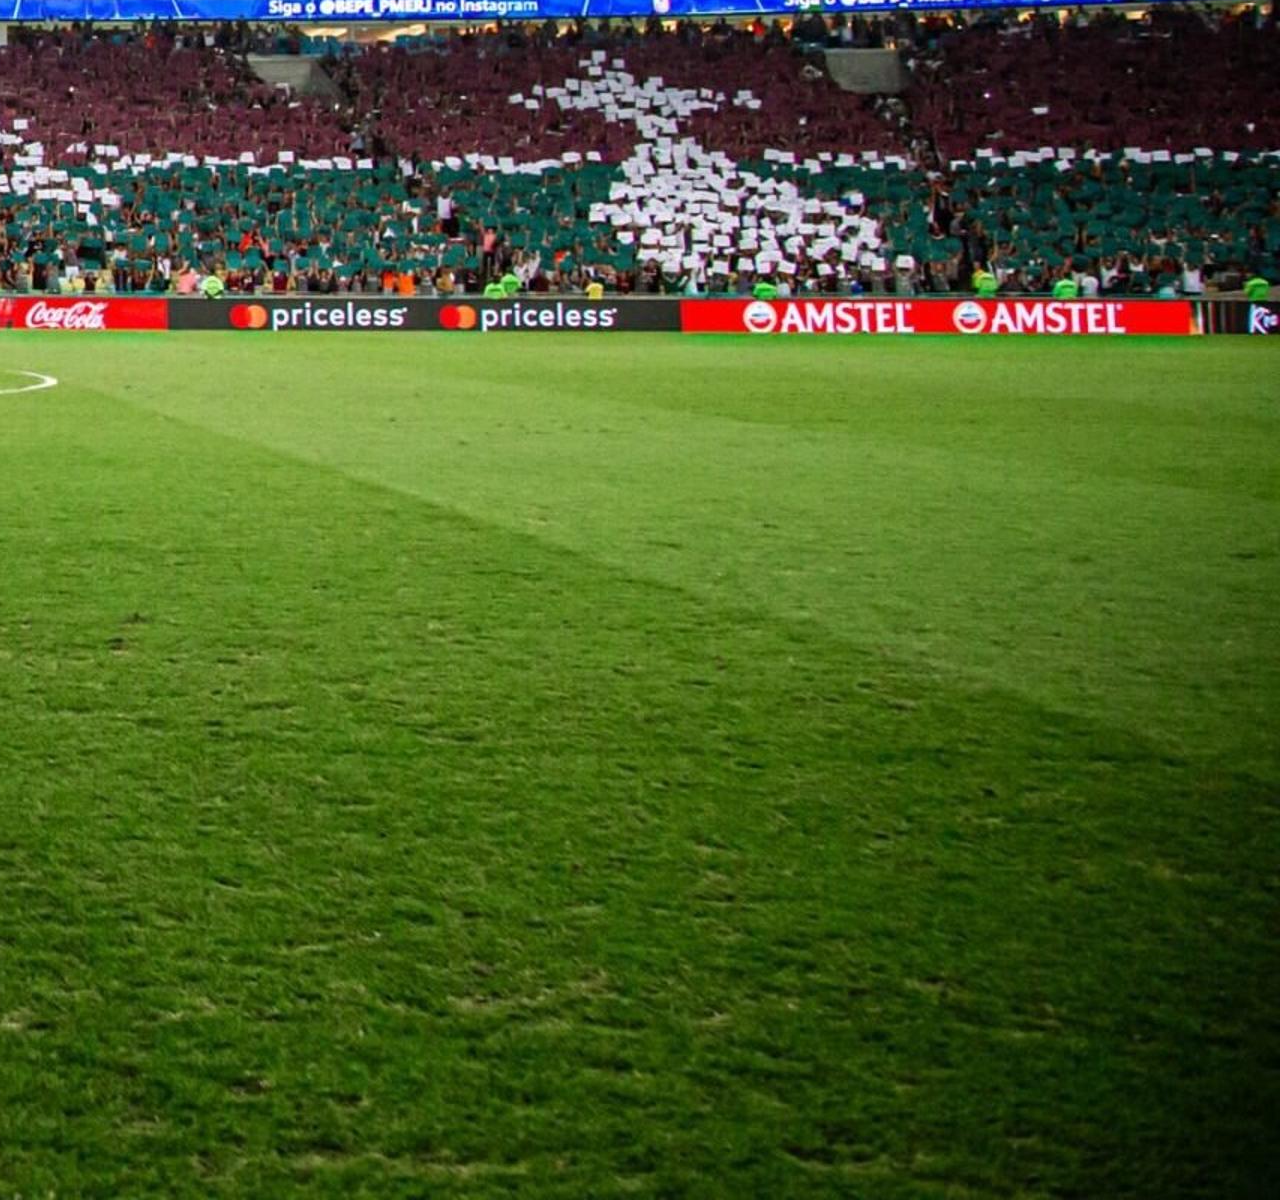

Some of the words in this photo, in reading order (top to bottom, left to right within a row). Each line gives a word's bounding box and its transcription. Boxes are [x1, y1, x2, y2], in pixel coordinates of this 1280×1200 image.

[268, 0, 301, 16] Siga
[306, 3, 316, 14] o
[435, 1, 455, 14] no
[26, 301, 106, 329] Coca-Cola
[273, 303, 404, 330] priceless
[482, 303, 615, 331] priceless
[781, 303, 914, 333] AMSTEL
[991, 303, 1125, 334] AMSTEL
